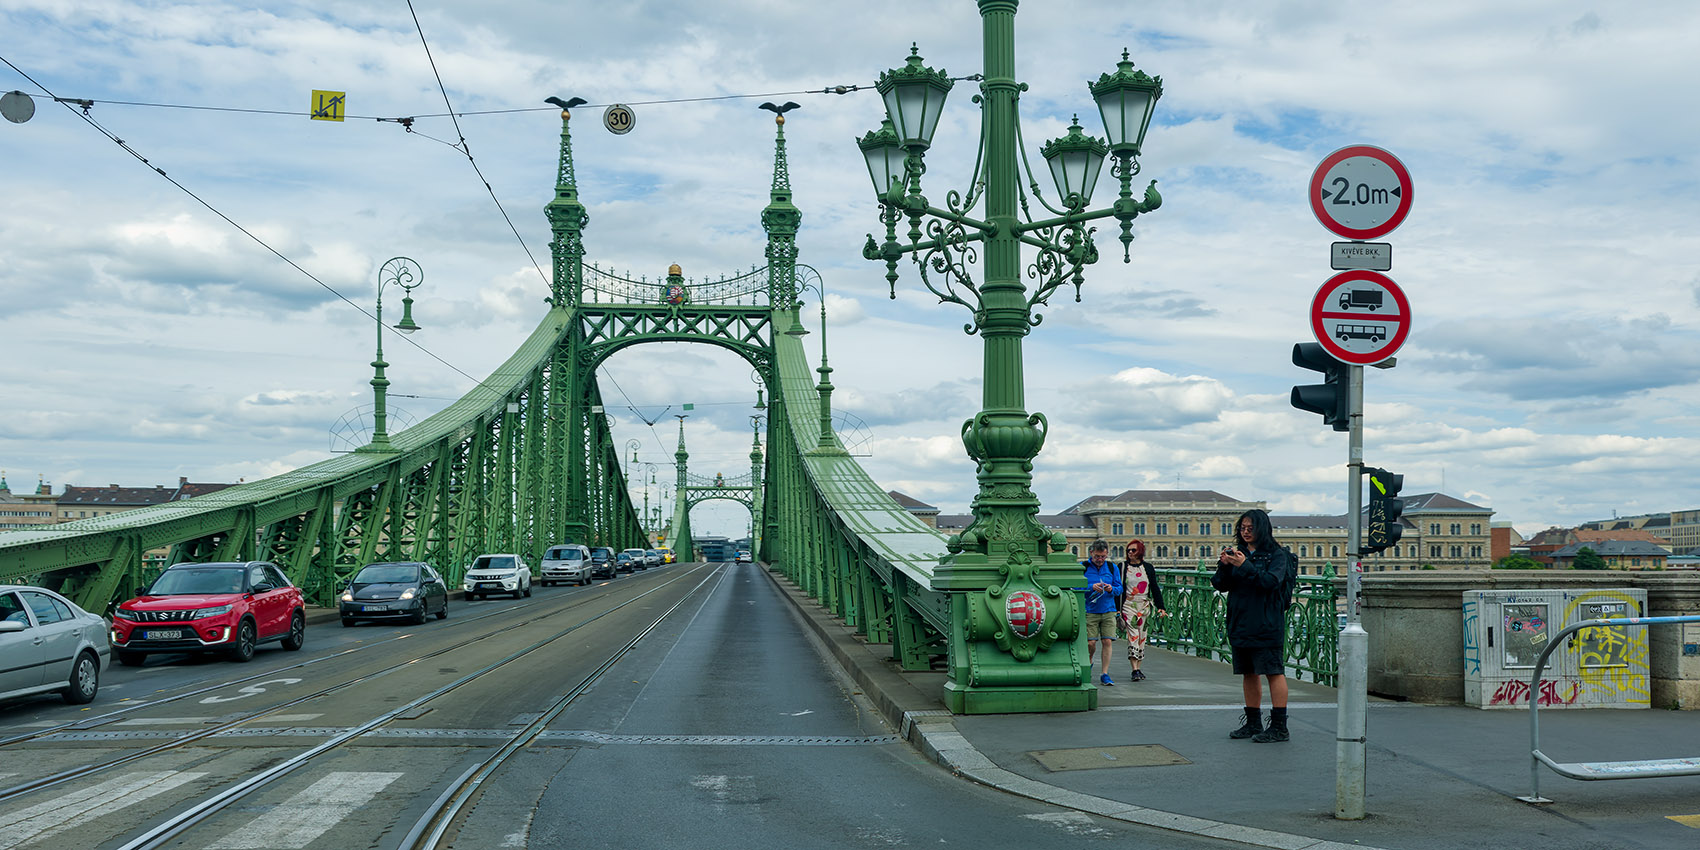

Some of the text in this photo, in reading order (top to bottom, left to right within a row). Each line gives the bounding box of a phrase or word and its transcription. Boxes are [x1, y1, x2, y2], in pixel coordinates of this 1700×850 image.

[610, 112, 629, 126] 30
[1341, 247, 1364, 255] KIVÉVE
[148, 631, 181, 639] SLX-373
